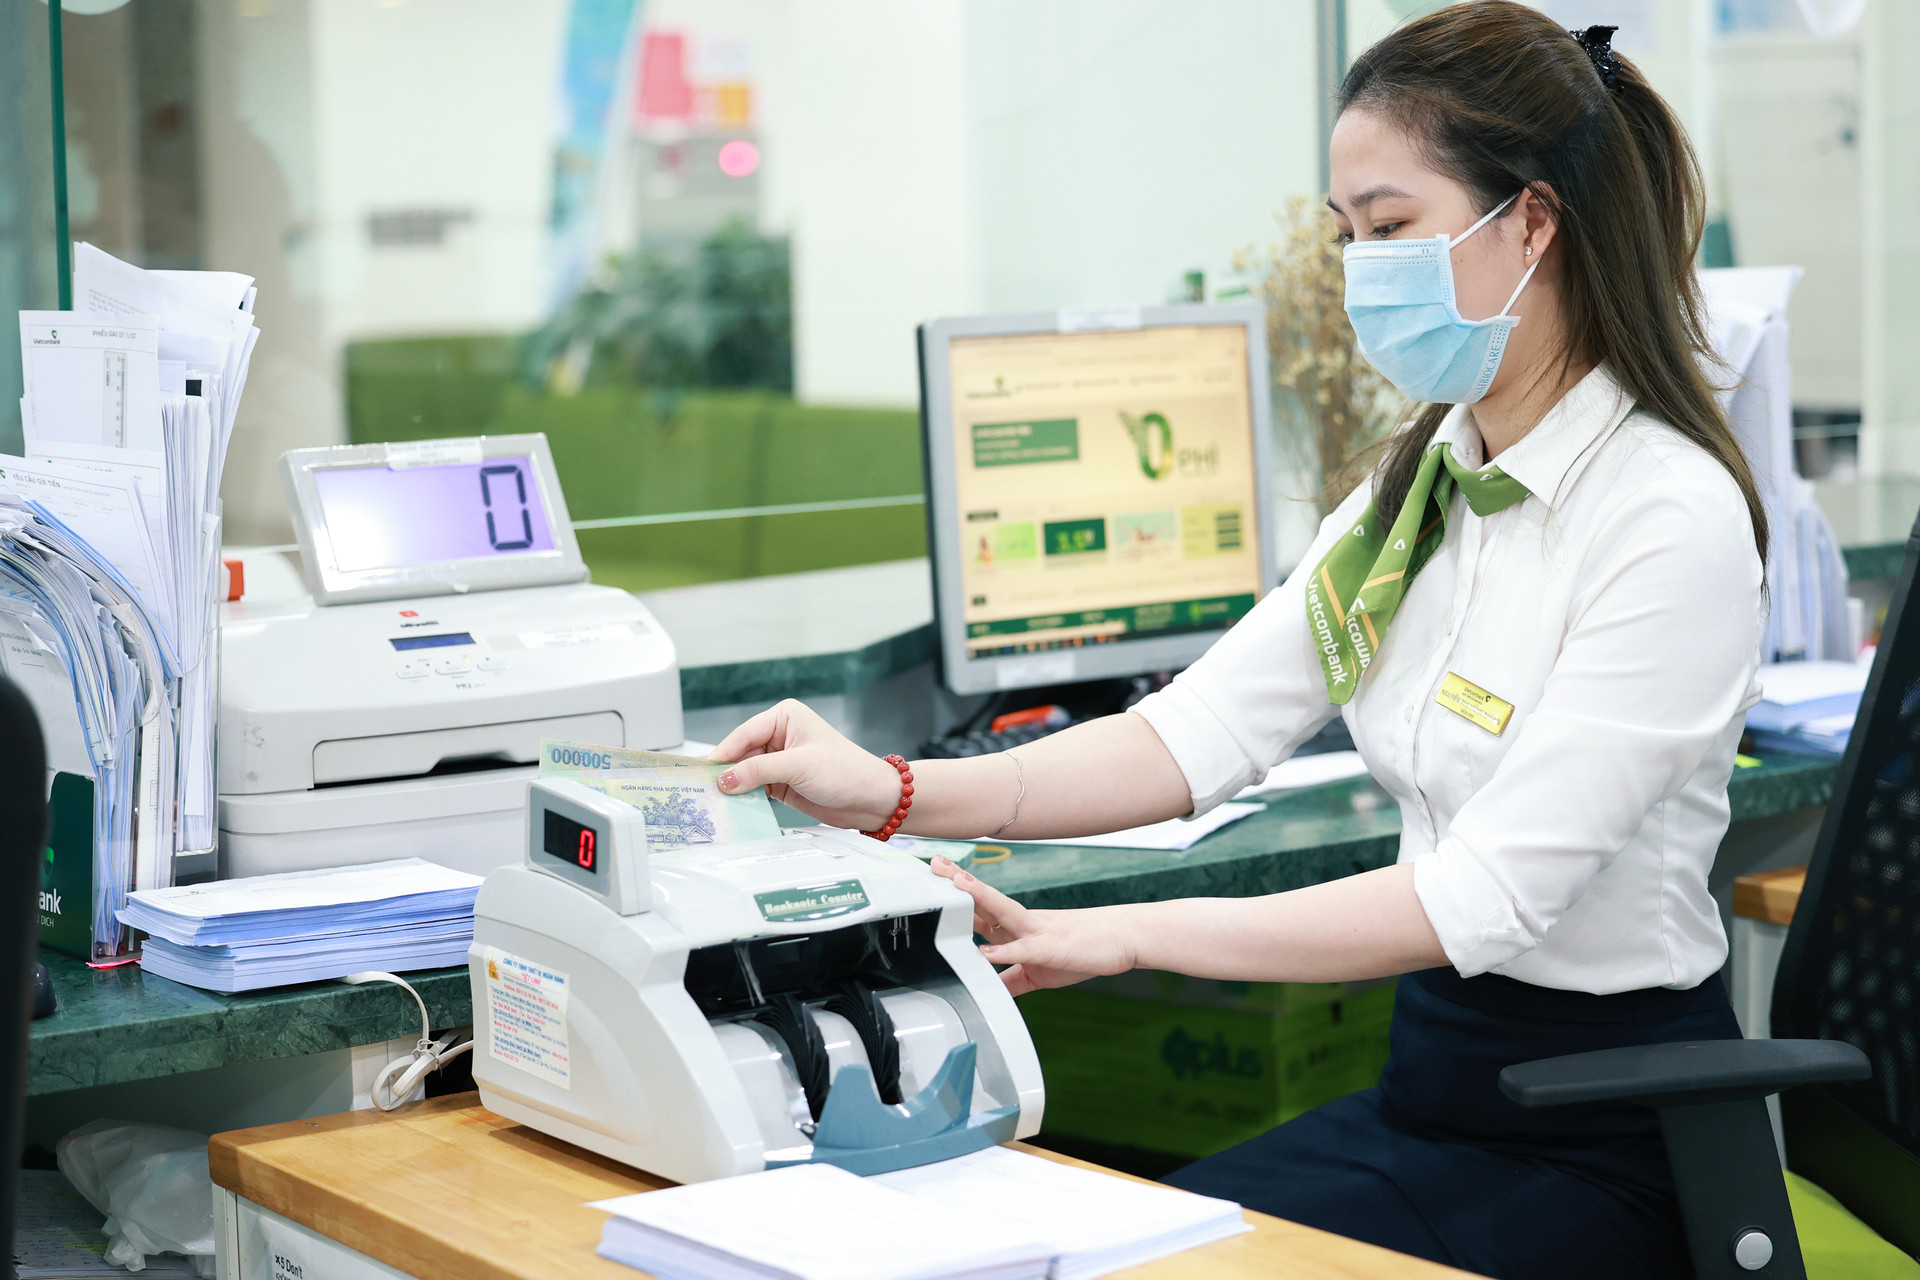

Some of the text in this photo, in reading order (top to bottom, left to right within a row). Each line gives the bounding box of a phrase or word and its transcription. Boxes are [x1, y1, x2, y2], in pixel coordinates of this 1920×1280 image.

[479, 464, 534, 551] 0
[1308, 575, 1348, 686] Vietcombank
[551, 747, 612, 770] 500000
[621, 783, 636, 791] NGÂN
[637, 784, 652, 792] HÀNG
[681, 785, 692, 793] VIỆT
[578, 828, 596, 869] 0
[39, 888, 62, 915] ank
[763, 891, 865, 915] Banknote Counter
